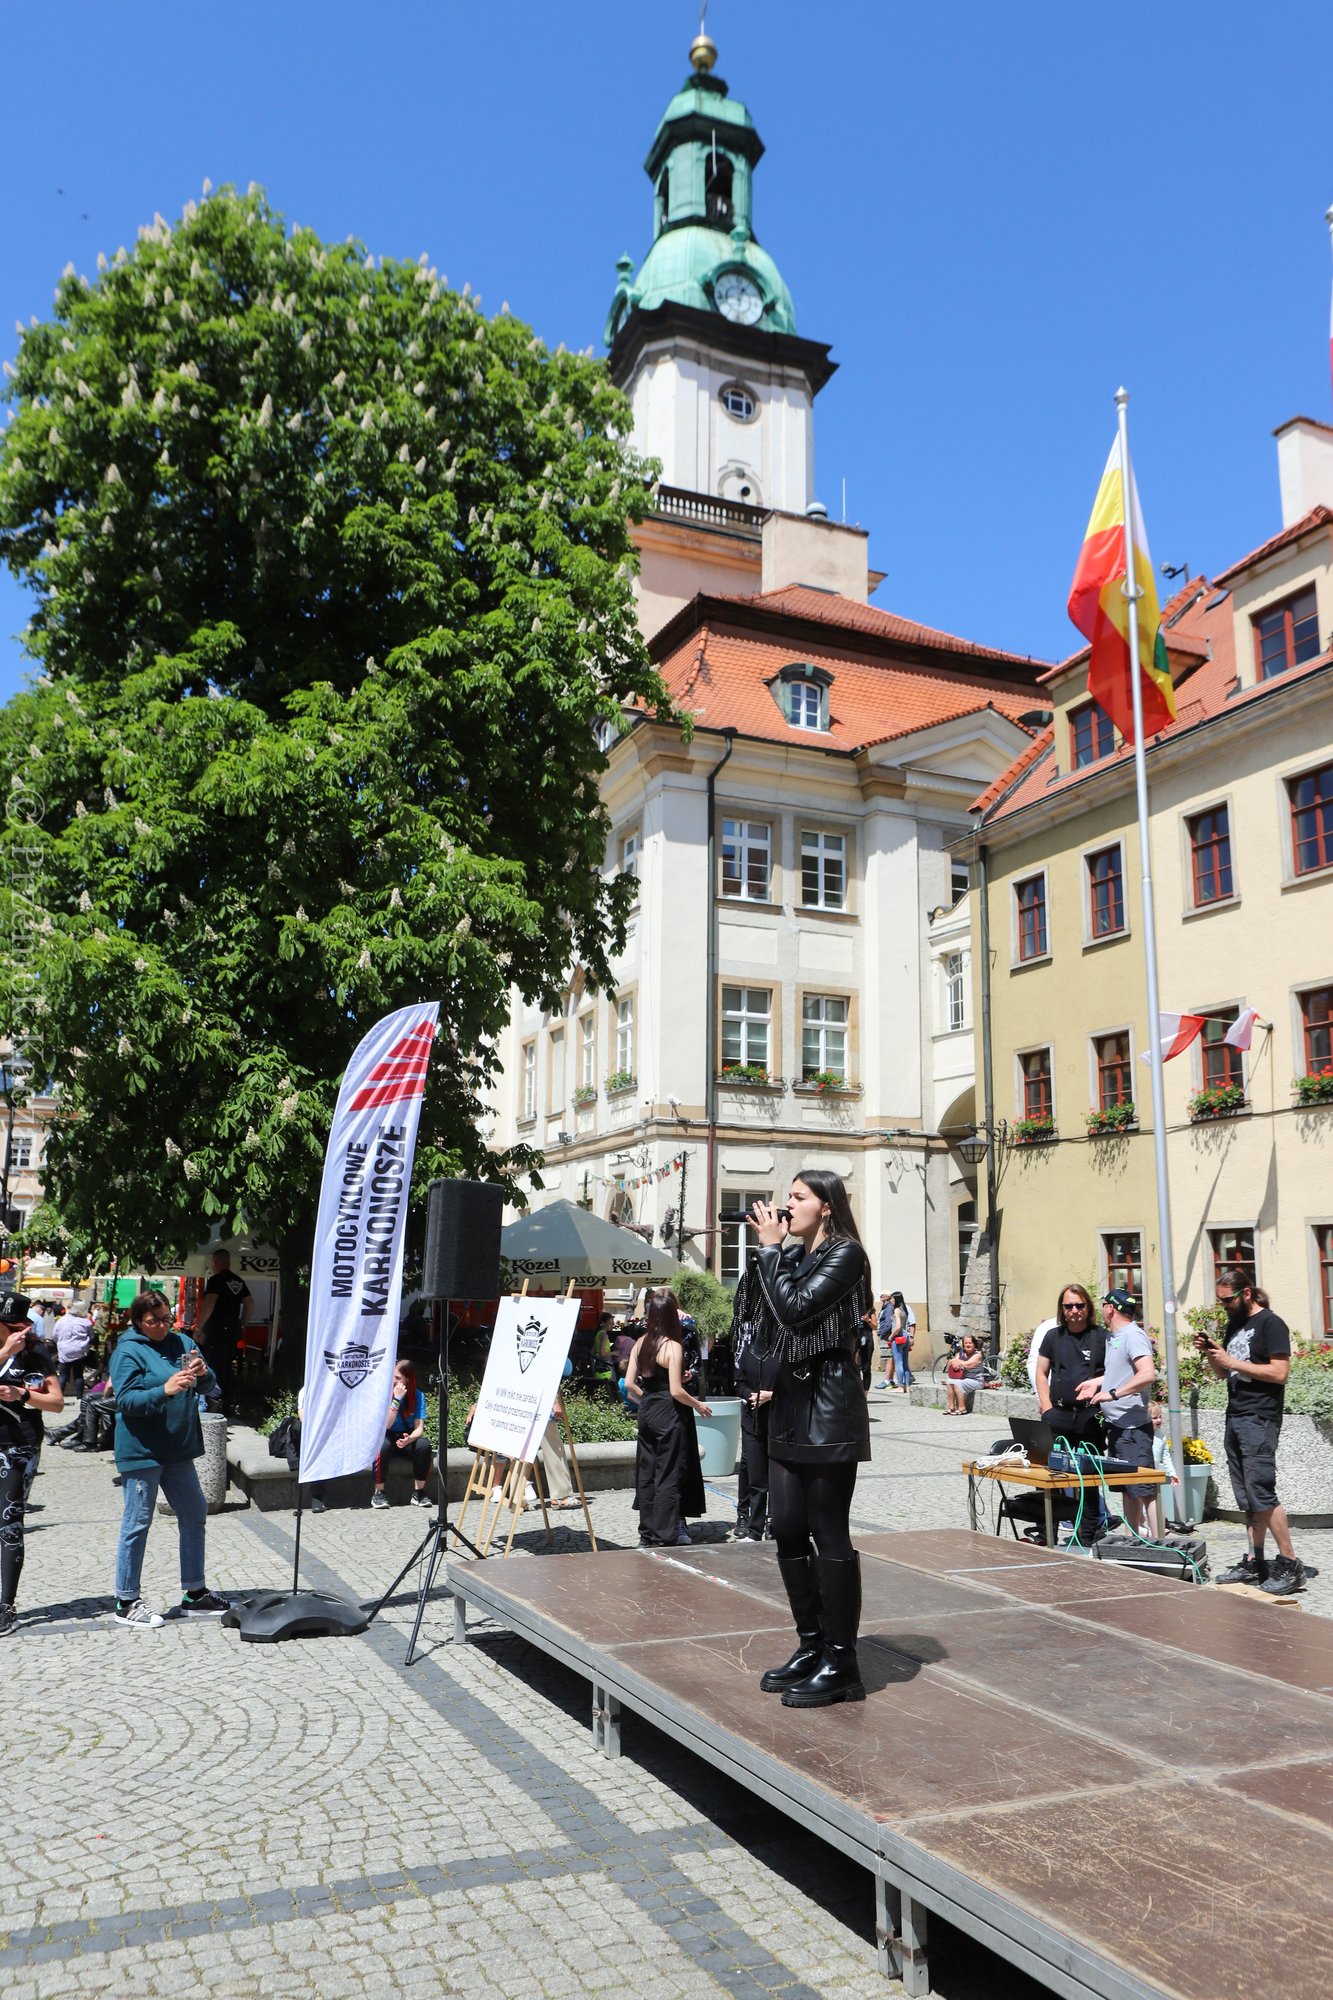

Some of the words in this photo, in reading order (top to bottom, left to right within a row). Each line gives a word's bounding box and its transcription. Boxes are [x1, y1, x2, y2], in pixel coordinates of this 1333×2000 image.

[331, 1142, 368, 1297] MOTOCYKLOWE
[361, 1126, 407, 1316] KARKONOSZE
[240, 1256, 280, 1272] Koz
[511, 1258, 560, 1274] Kozel
[612, 1258, 652, 1274] Kozel
[337, 1360, 370, 1369] KARKONOSZE
